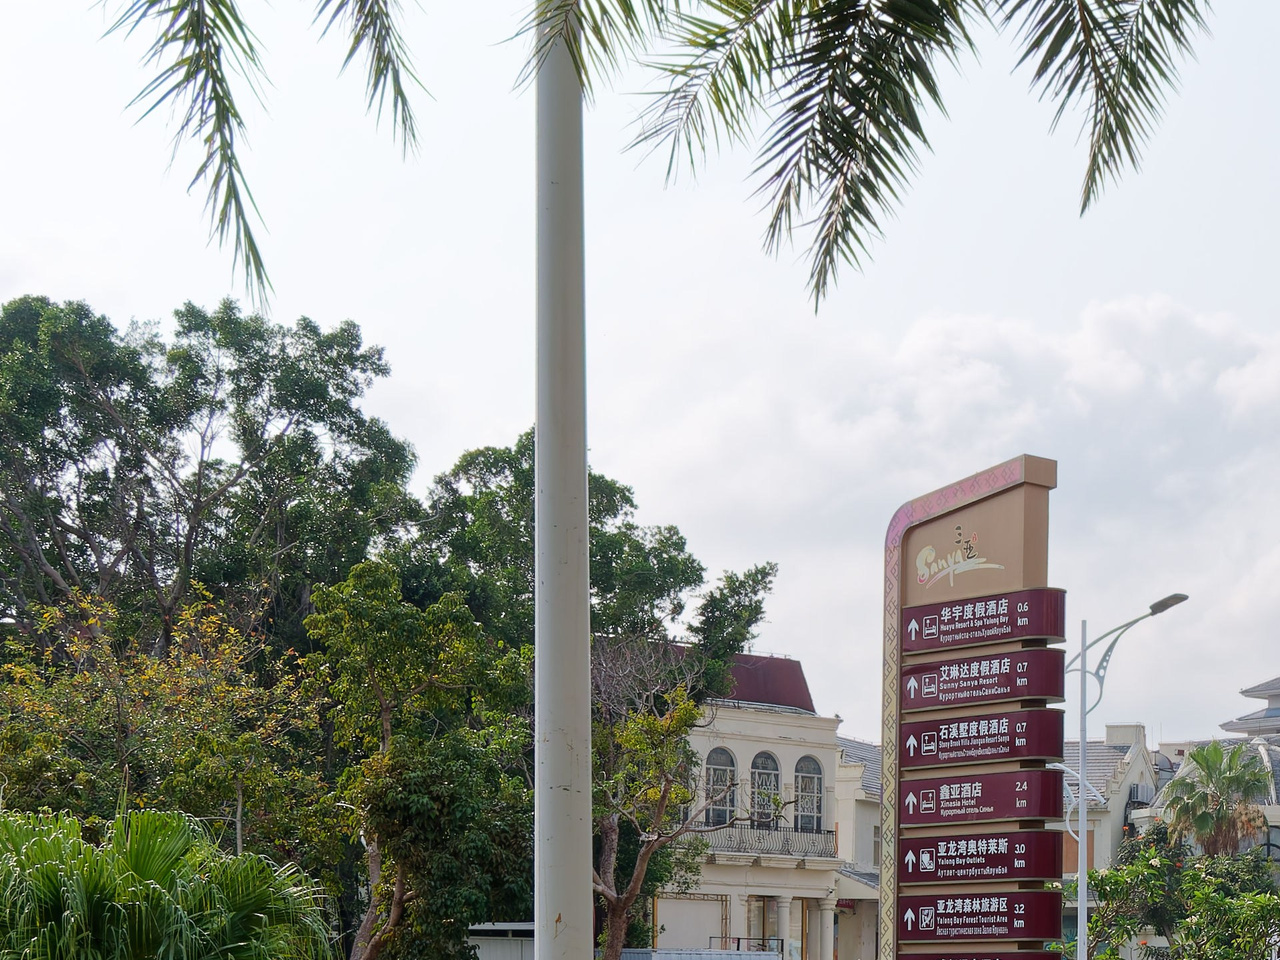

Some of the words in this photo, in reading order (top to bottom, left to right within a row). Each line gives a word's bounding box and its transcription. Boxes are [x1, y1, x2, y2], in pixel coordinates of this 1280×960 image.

[940, 598, 1009, 623] 华宇度假酒店
[1017, 602, 1028, 612] 0.6
[955, 621, 970, 629] Resort
[983, 617, 999, 625] Yalong
[1018, 616, 1028, 626] km
[940, 657, 1010, 681] 艾琳达度假酒店
[1017, 662, 1028, 672] 0.7
[940, 682, 959, 690] Sunny
[979, 676, 998, 685] Resort
[1017, 677, 1027, 686] km
[940, 717, 1009, 740] 石溪墅度假酒店
[1016, 722, 1027, 733] 0.7
[1016, 737, 1026, 747] km
[940, 782, 982, 800] 鑫亚酒店
[1016, 782, 1028, 791] 2.4
[962, 798, 976, 806] Hotel
[1016, 798, 1027, 808] km
[938, 838, 1009, 856] 亚龙湾奥特莱斯
[938, 858, 955, 867] Yalong
[956, 857, 966, 866] Bay
[966, 856, 986, 864] Outlets
[1014, 859, 1025, 868] km
[936, 897, 1008, 914] 亚龙湾森林旅游区
[936, 916, 953, 926] Yalong
[954, 916, 963, 926] Bay
[963, 916, 979, 924] Forest
[979, 915, 996, 923] Tourist
[996, 915, 1008, 923] Area
[1014, 918, 1024, 928] km
